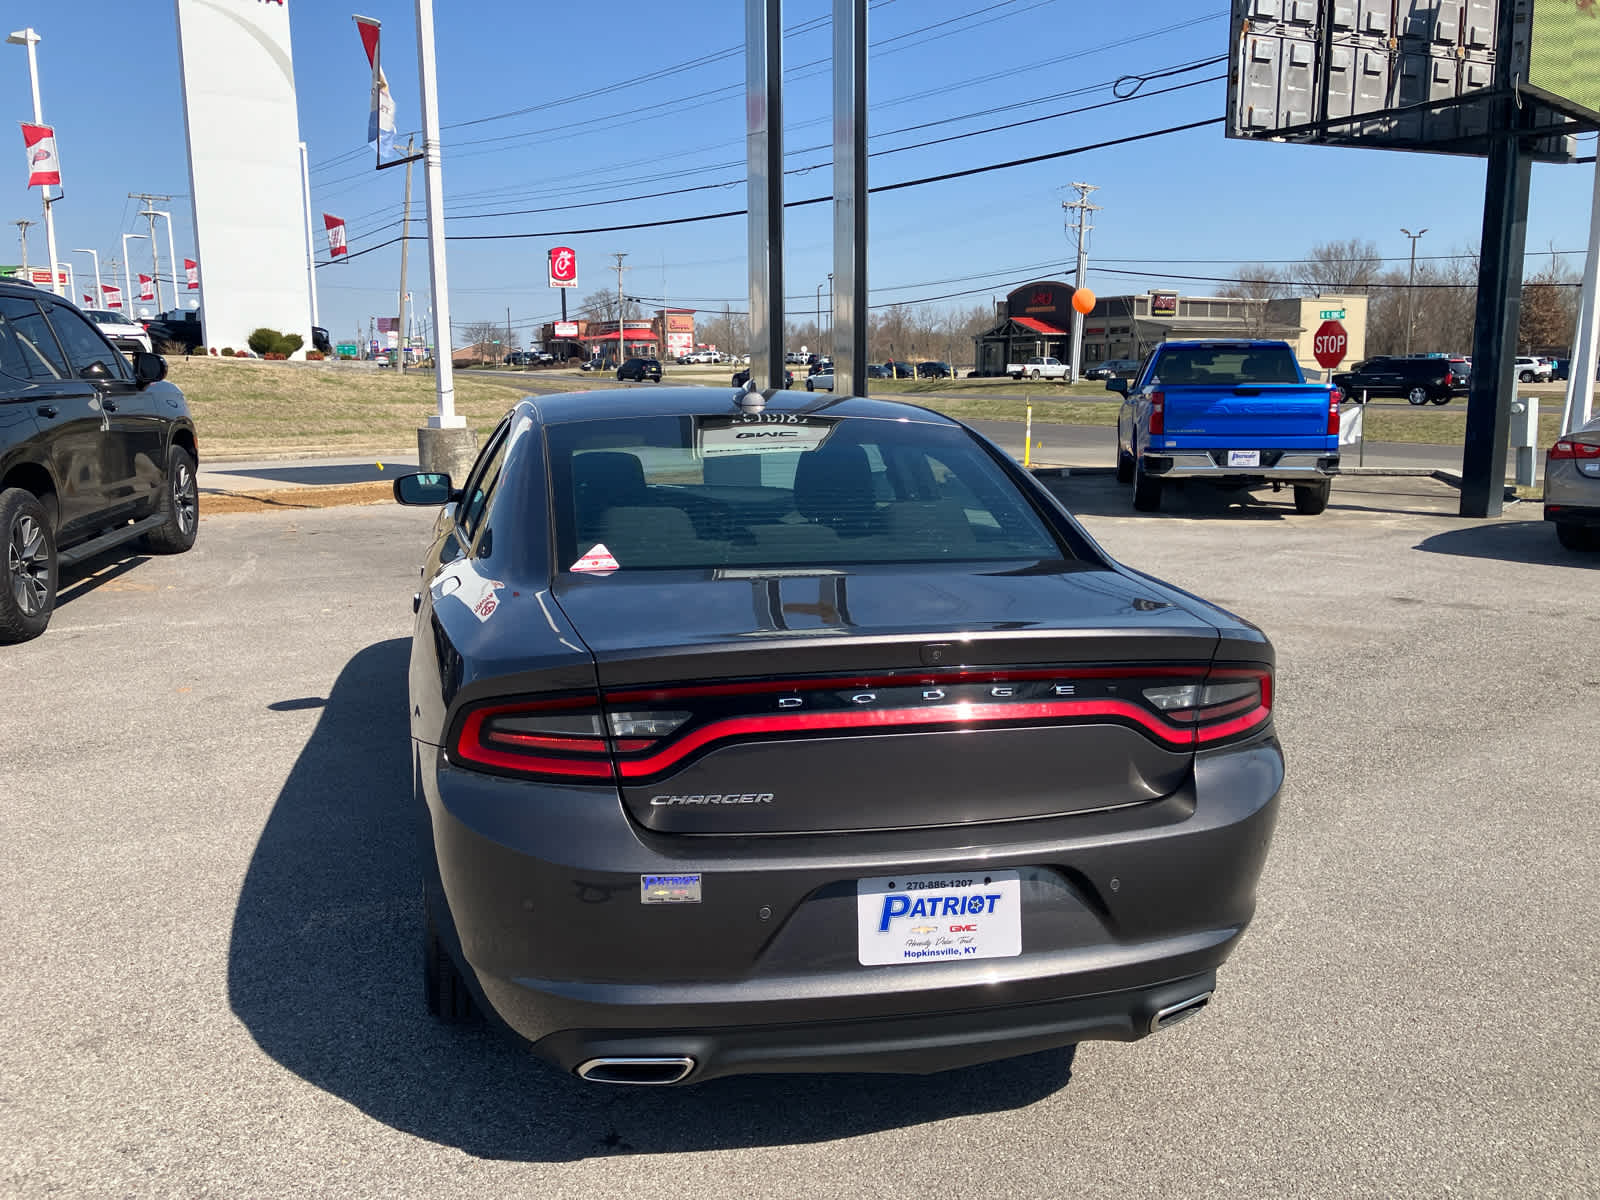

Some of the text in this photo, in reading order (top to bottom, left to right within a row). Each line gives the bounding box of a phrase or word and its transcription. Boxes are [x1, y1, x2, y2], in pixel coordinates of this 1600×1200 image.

[1315, 335, 1345, 353] STOP
[778, 684, 1076, 707] DODGE
[650, 793, 774, 806] CHARGER
[906, 879, 973, 890] 270-886-1207
[878, 893, 1002, 932] PATRIOT
[904, 946, 977, 958] Hopkinsville, KY
